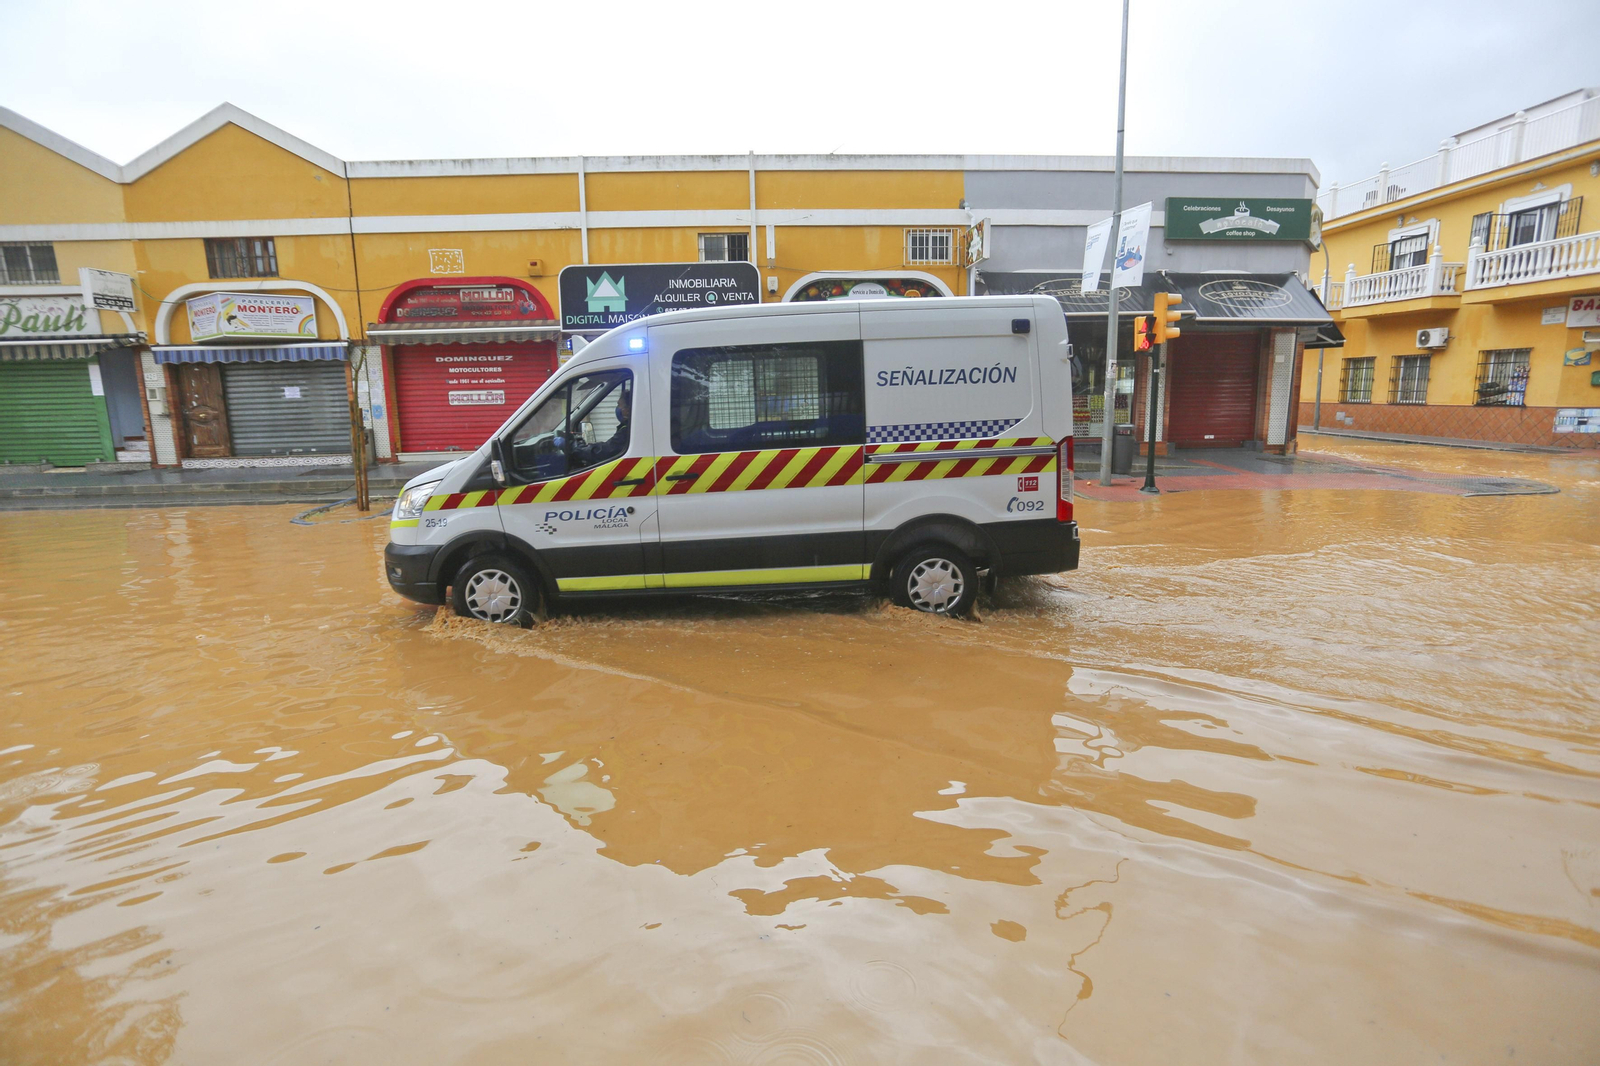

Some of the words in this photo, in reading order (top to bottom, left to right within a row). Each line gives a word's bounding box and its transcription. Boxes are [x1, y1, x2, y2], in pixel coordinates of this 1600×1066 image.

[668, 278, 738, 289] INMOBILIARIA
[653, 293, 701, 303] ALQUILER
[722, 292, 754, 302] VENTA
[237, 305, 299, 315] MONTERO
[0, 303, 87, 335] Pauli
[566, 315, 606, 325] DIGITAL
[435, 355, 514, 363] DOMINGUEZ
[876, 362, 1017, 387] SEÑALIZACIÓN
[1016, 500, 1045, 512] 092
[544, 506, 628, 522] POLICÍA
[425, 518, 448, 528] 25-19
